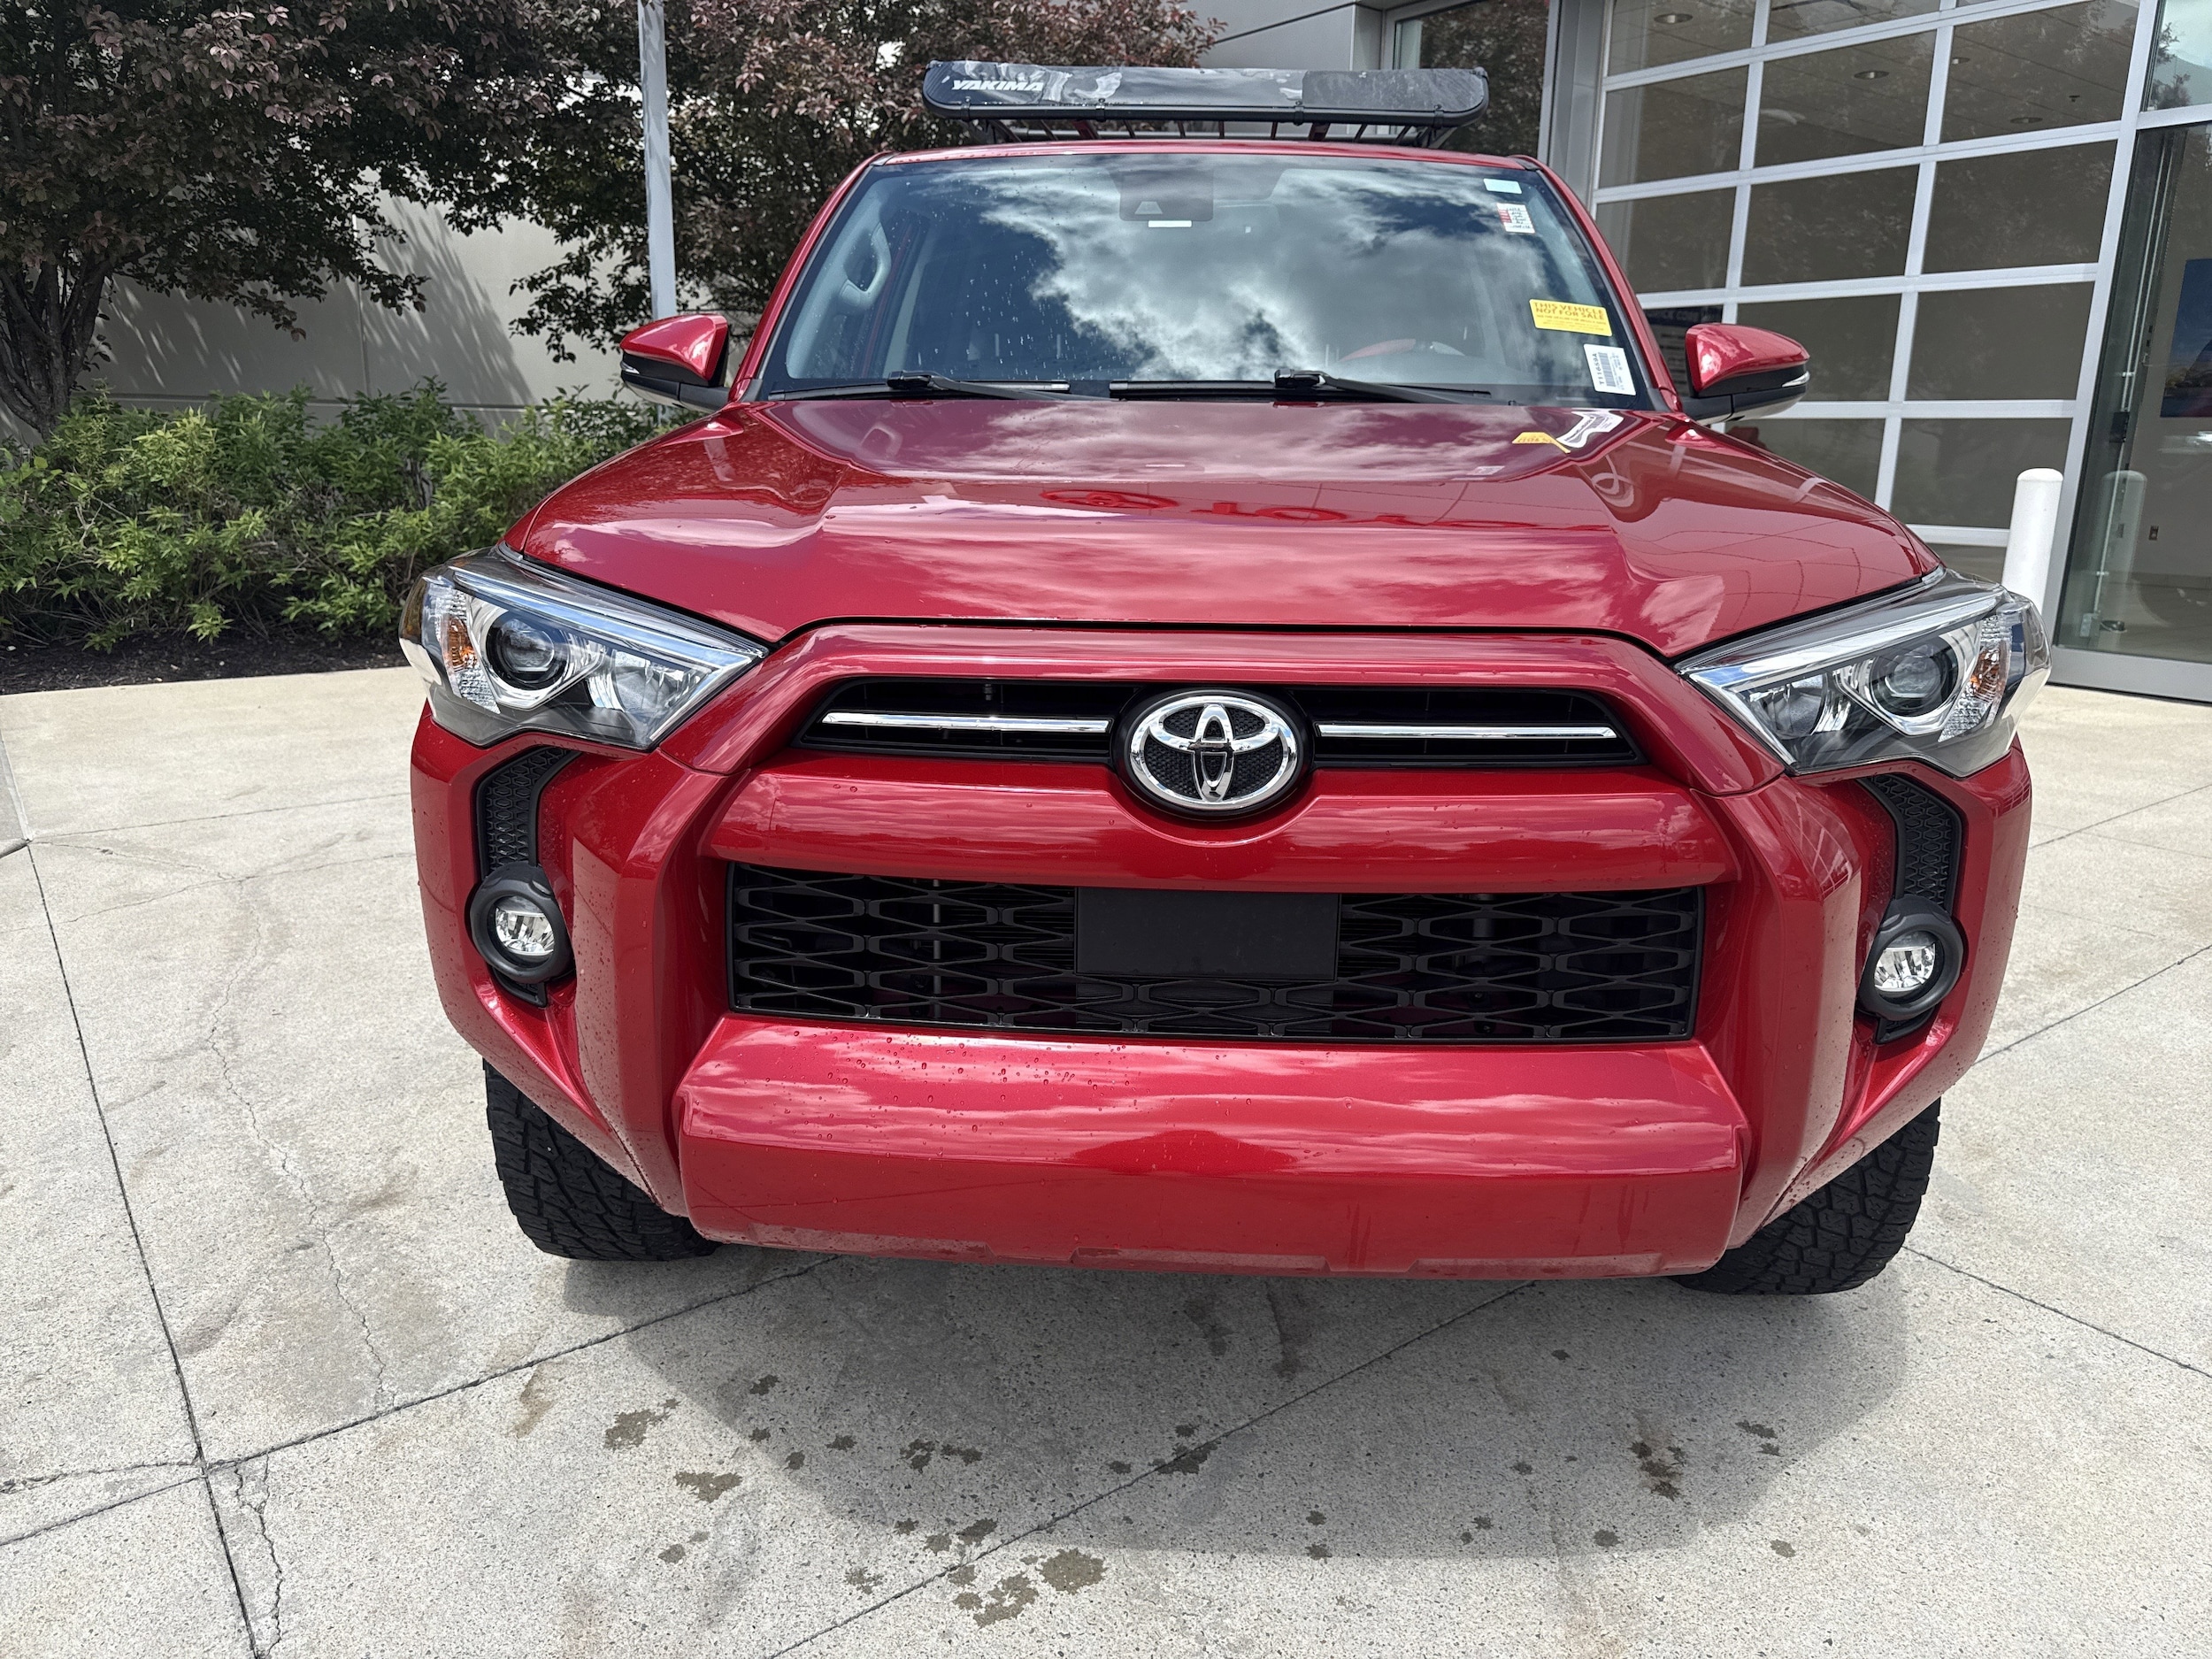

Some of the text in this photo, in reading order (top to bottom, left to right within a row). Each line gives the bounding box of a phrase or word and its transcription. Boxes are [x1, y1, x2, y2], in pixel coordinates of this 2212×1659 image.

[951, 80, 1044, 91] YAKIMA
[1534, 302, 1604, 315] THIS VEHICLE
